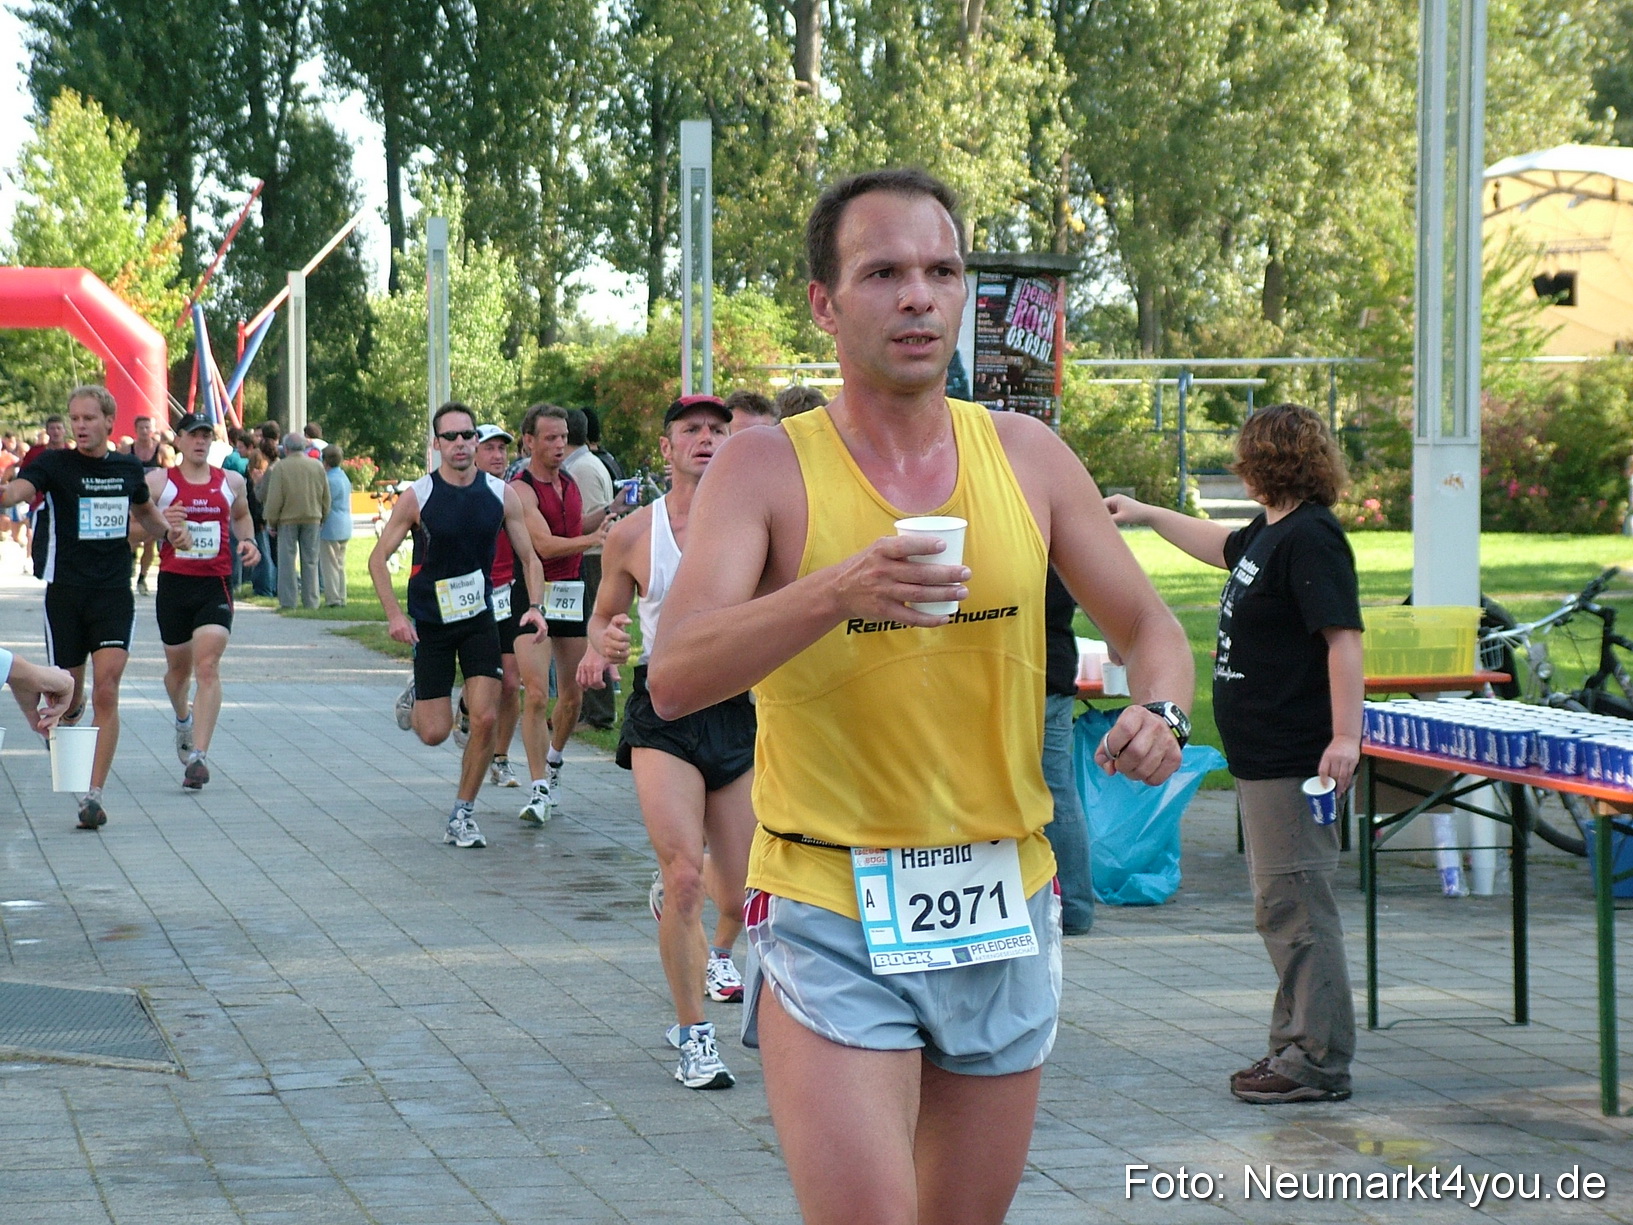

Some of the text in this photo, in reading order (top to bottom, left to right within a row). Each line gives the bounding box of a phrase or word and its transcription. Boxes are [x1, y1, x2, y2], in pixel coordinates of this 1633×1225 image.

[1012, 299, 1057, 344] ROCK
[1006, 325, 1053, 363] 08.09.07
[93, 502, 123, 511] Wolfgang
[94, 515, 125, 528] 3290
[193, 538, 214, 549] 454
[450, 578, 476, 591] Michael
[552, 585, 570, 593] Franz
[458, 591, 481, 607] 394
[555, 598, 576, 609] 787
[901, 844, 973, 869] Harald
[866, 888, 876, 908] A
[908, 880, 1009, 933] 2971
[970, 935, 1035, 955] PFLEIDERER
[873, 950, 934, 968] BOCK
